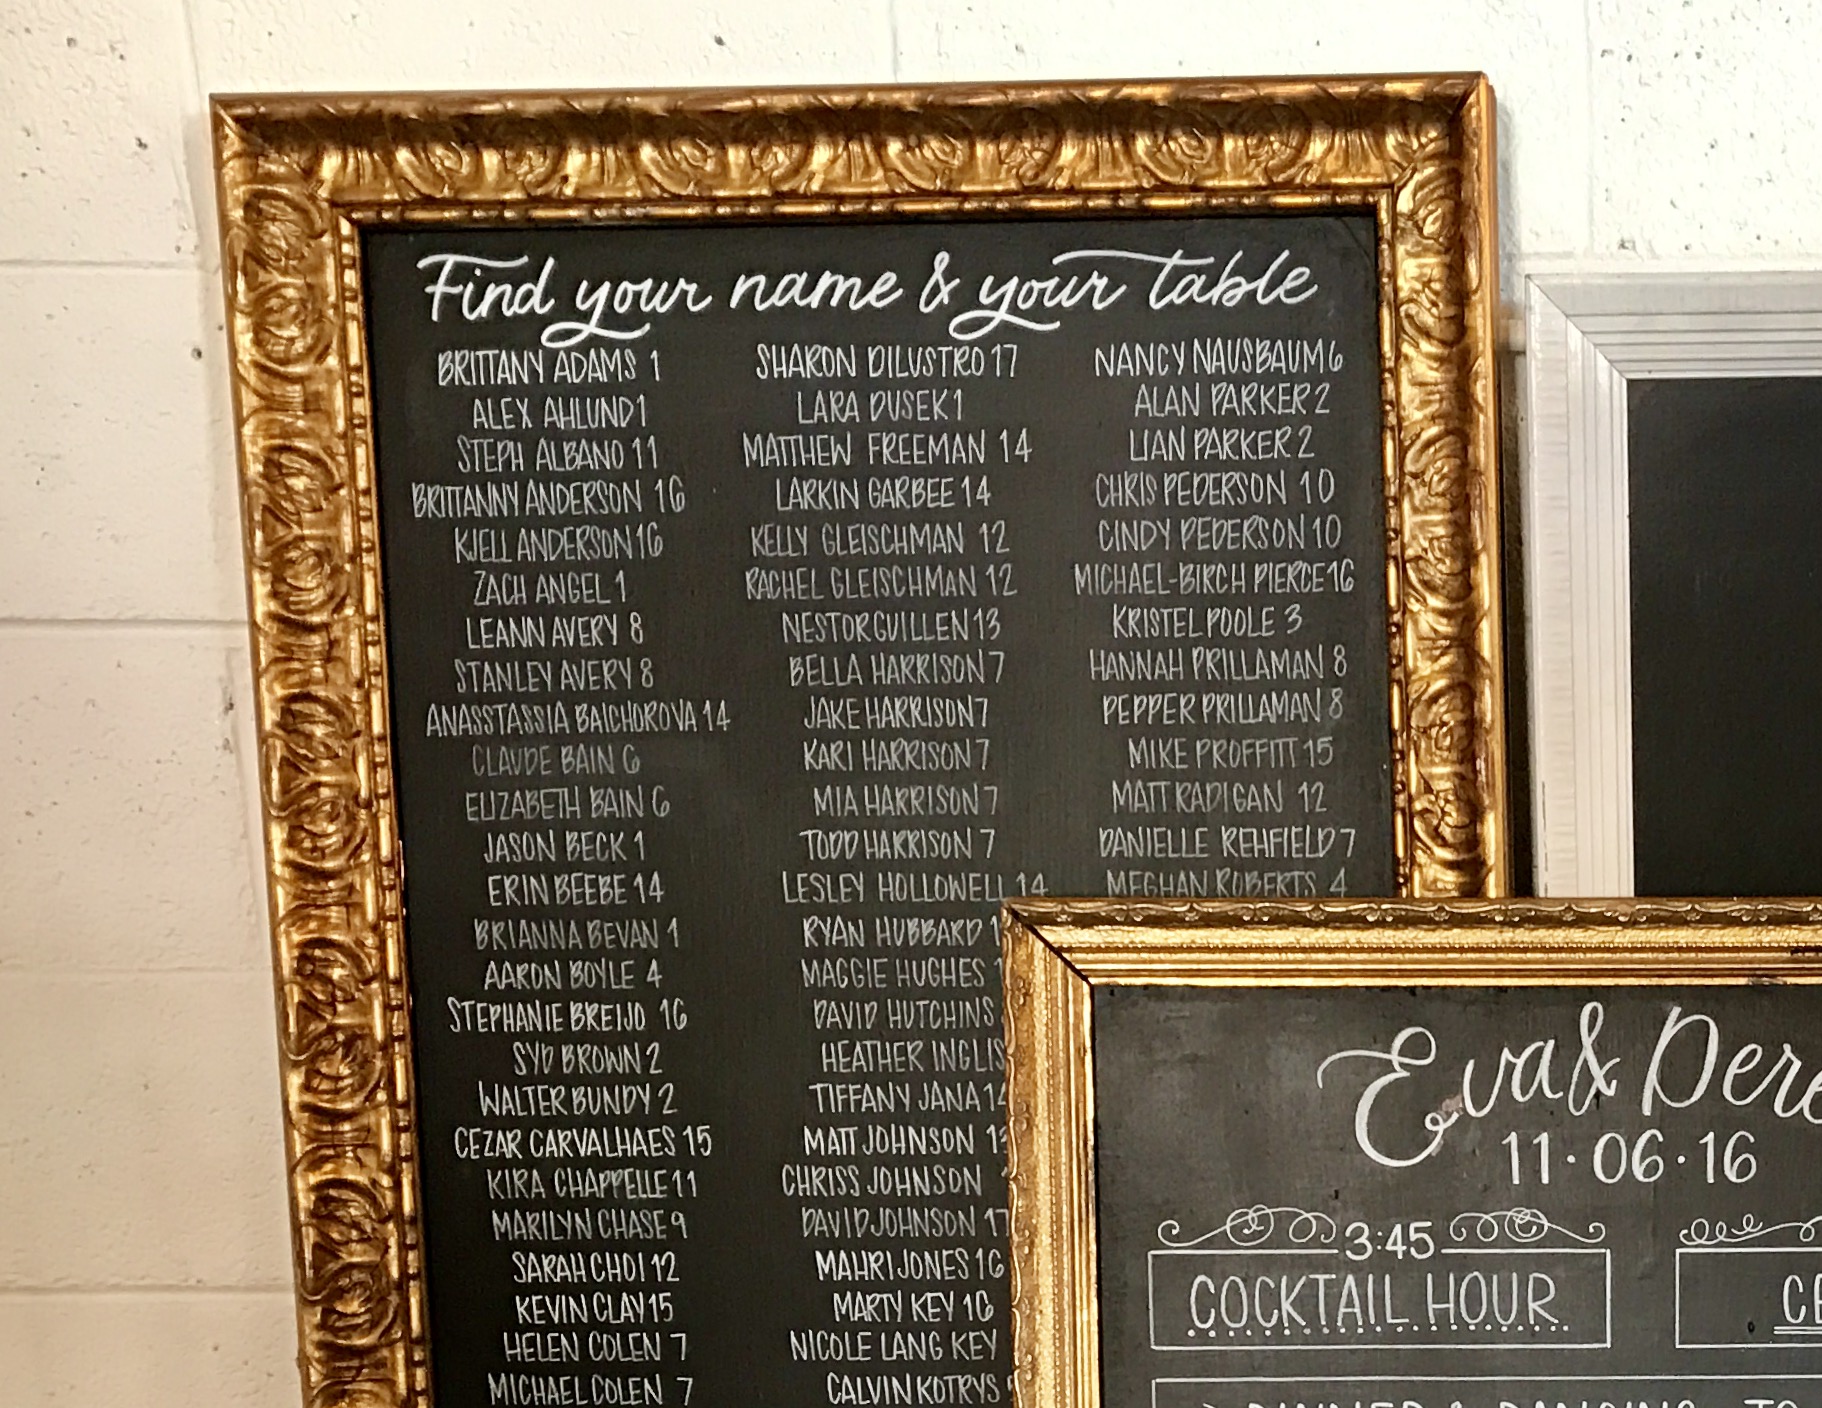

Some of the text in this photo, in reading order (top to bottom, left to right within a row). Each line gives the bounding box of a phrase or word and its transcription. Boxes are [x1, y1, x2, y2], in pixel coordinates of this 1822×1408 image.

[416, 248, 1320, 349] Find your name & your table
[437, 349, 662, 386] BRITTANY ADAMS 1
[756, 343, 1019, 380] SHARON DILUSTRO 17
[1094, 338, 1345, 378] NANCY NAUSBAUM 6
[1133, 380, 1332, 418] ALAN PARKER 2
[1095, 468, 1336, 509] CHRIS PEDERSON 10
[789, 650, 1005, 688] BELLA HARRISON 7
[1089, 643, 1348, 682] HANNAH PRILLAMAN 8
[483, 829, 647, 864] JASON BECK 1
[1316, 1025, 1565, 1168] Eva
[1567, 1000, 1621, 1116] &
[454, 1124, 713, 1160] CEZAR CARVALHAES 15
[1343, 1219, 1436, 1261] 3:45
[1189, 1270, 1560, 1330] COCKTAIL HOUR
[502, 1330, 688, 1363] HELEN COLEN 7
